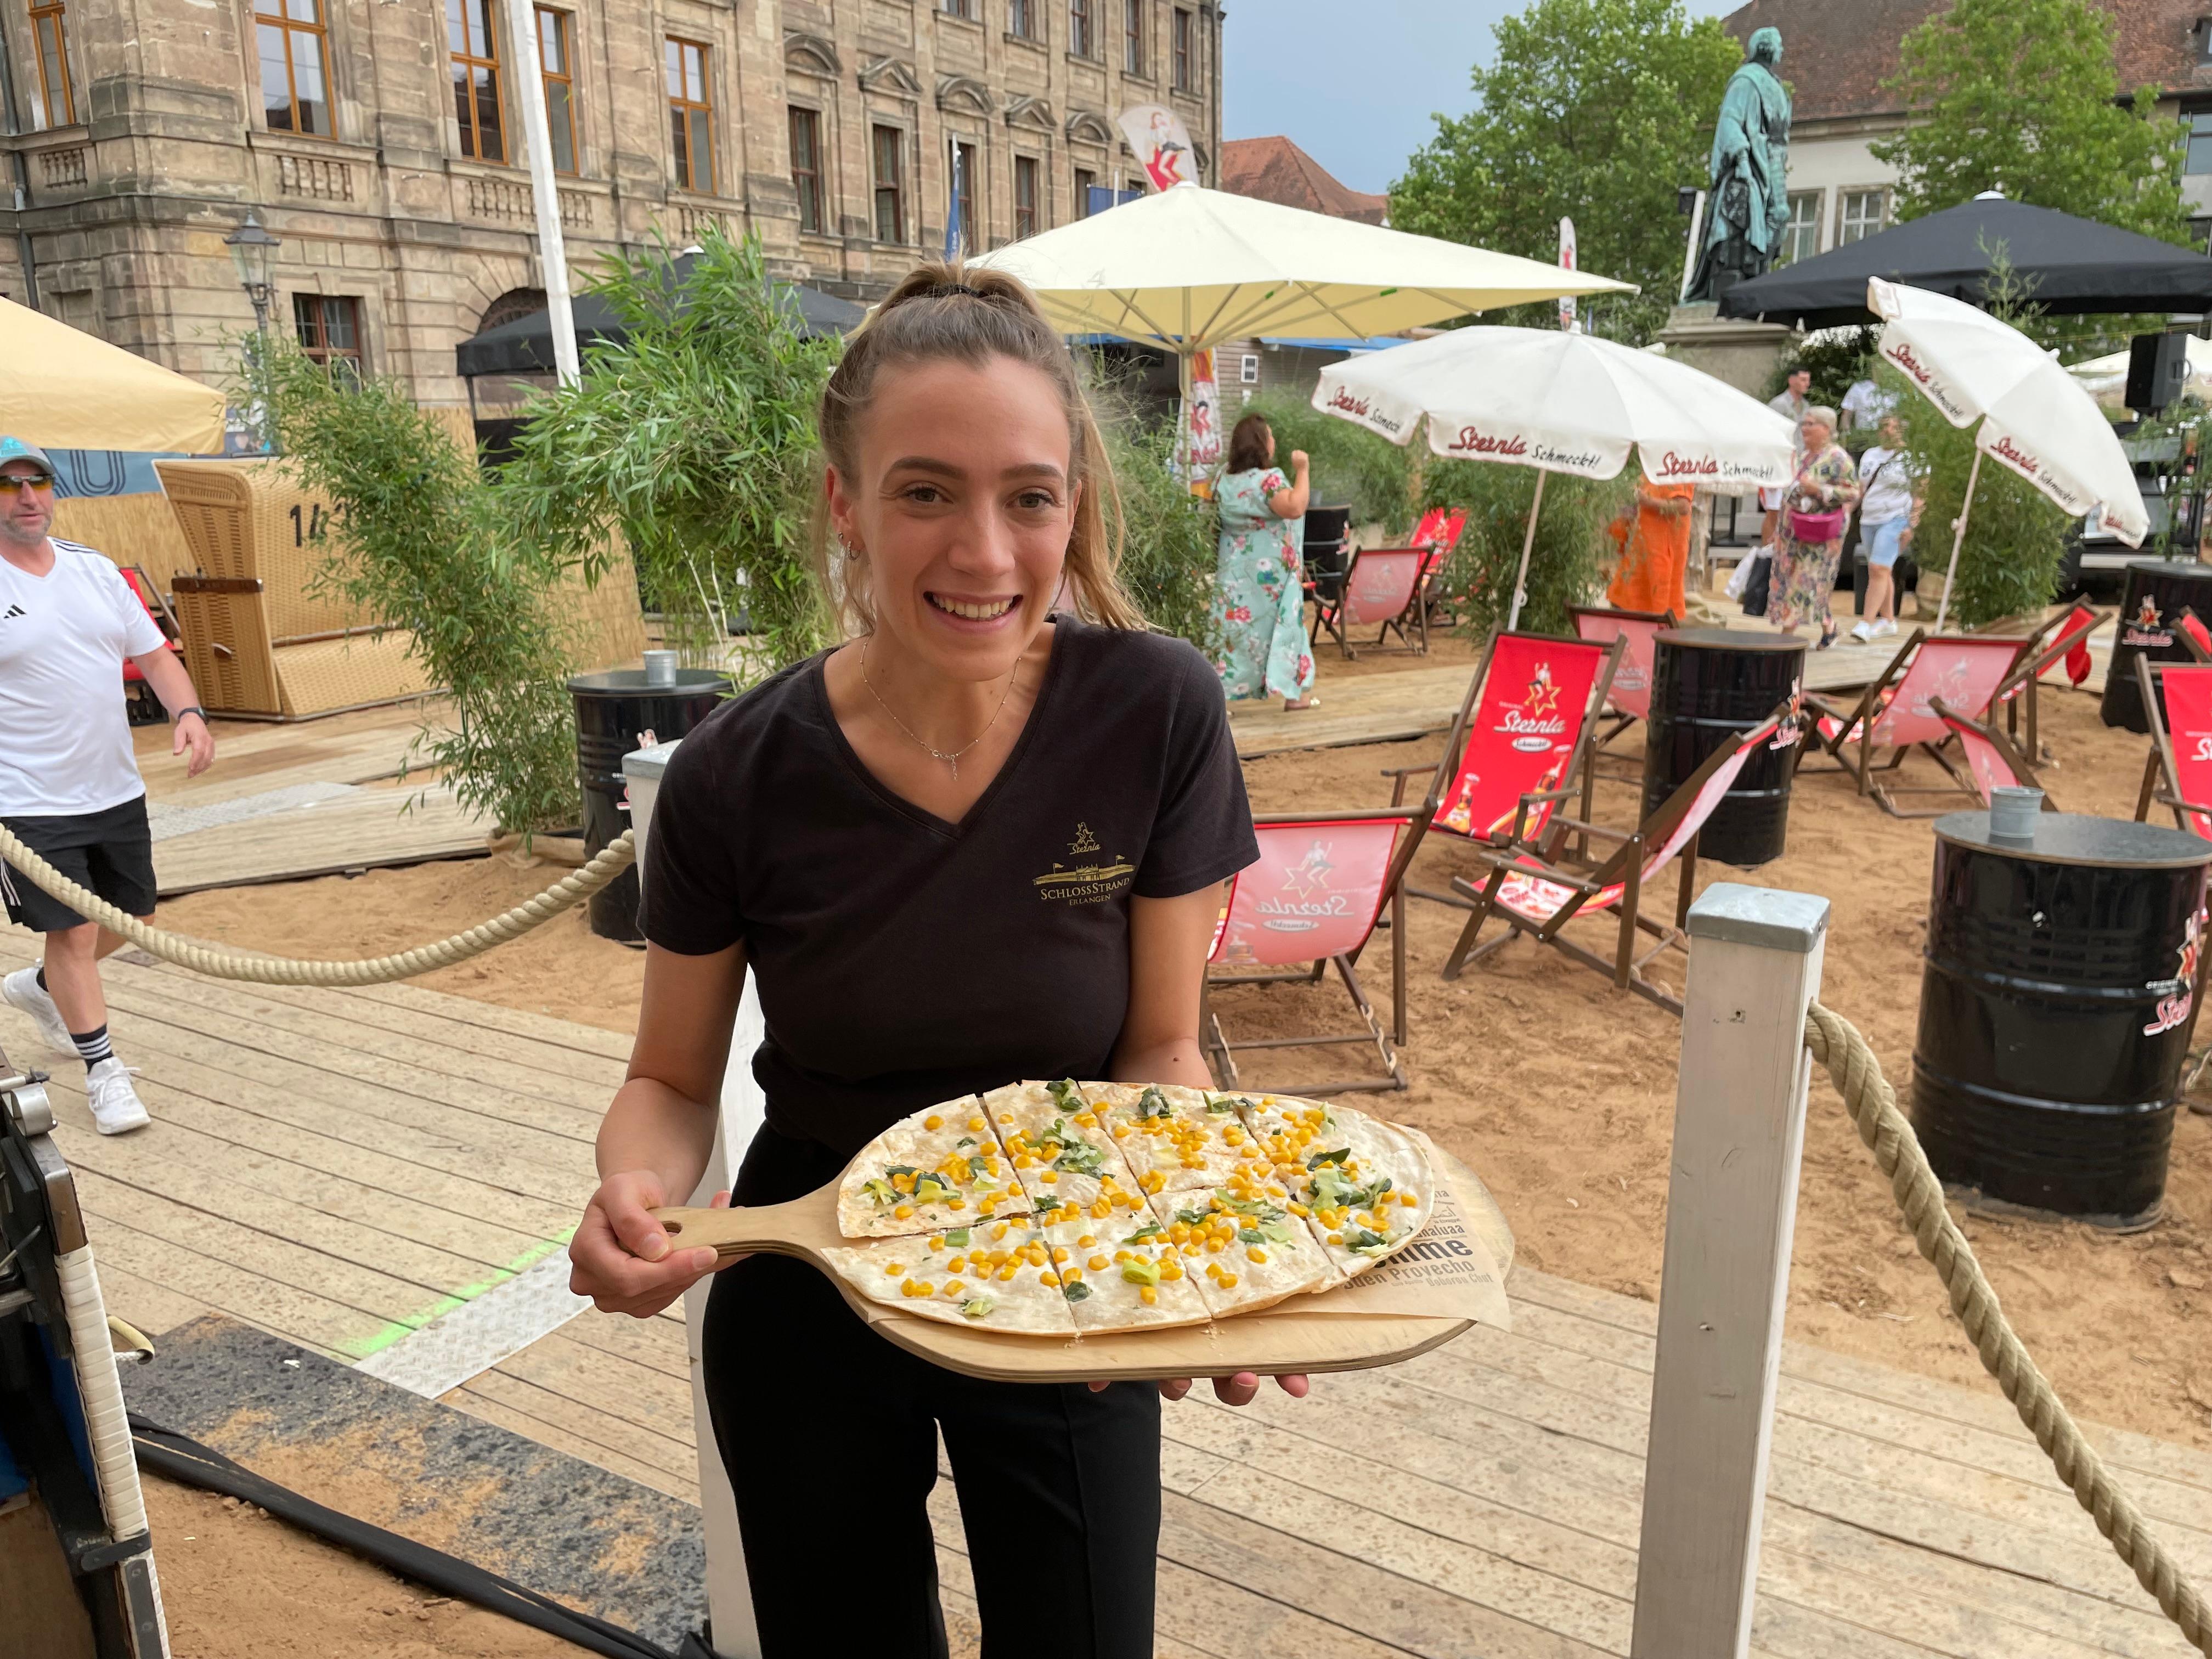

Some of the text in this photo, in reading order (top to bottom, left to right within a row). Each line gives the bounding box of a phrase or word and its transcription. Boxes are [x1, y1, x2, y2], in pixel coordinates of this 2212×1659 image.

[1493, 710, 1566, 734] Sternla
[1069, 893, 1111, 905] ERLANGEN
[1387, 1260, 1475, 1280] Provecho
